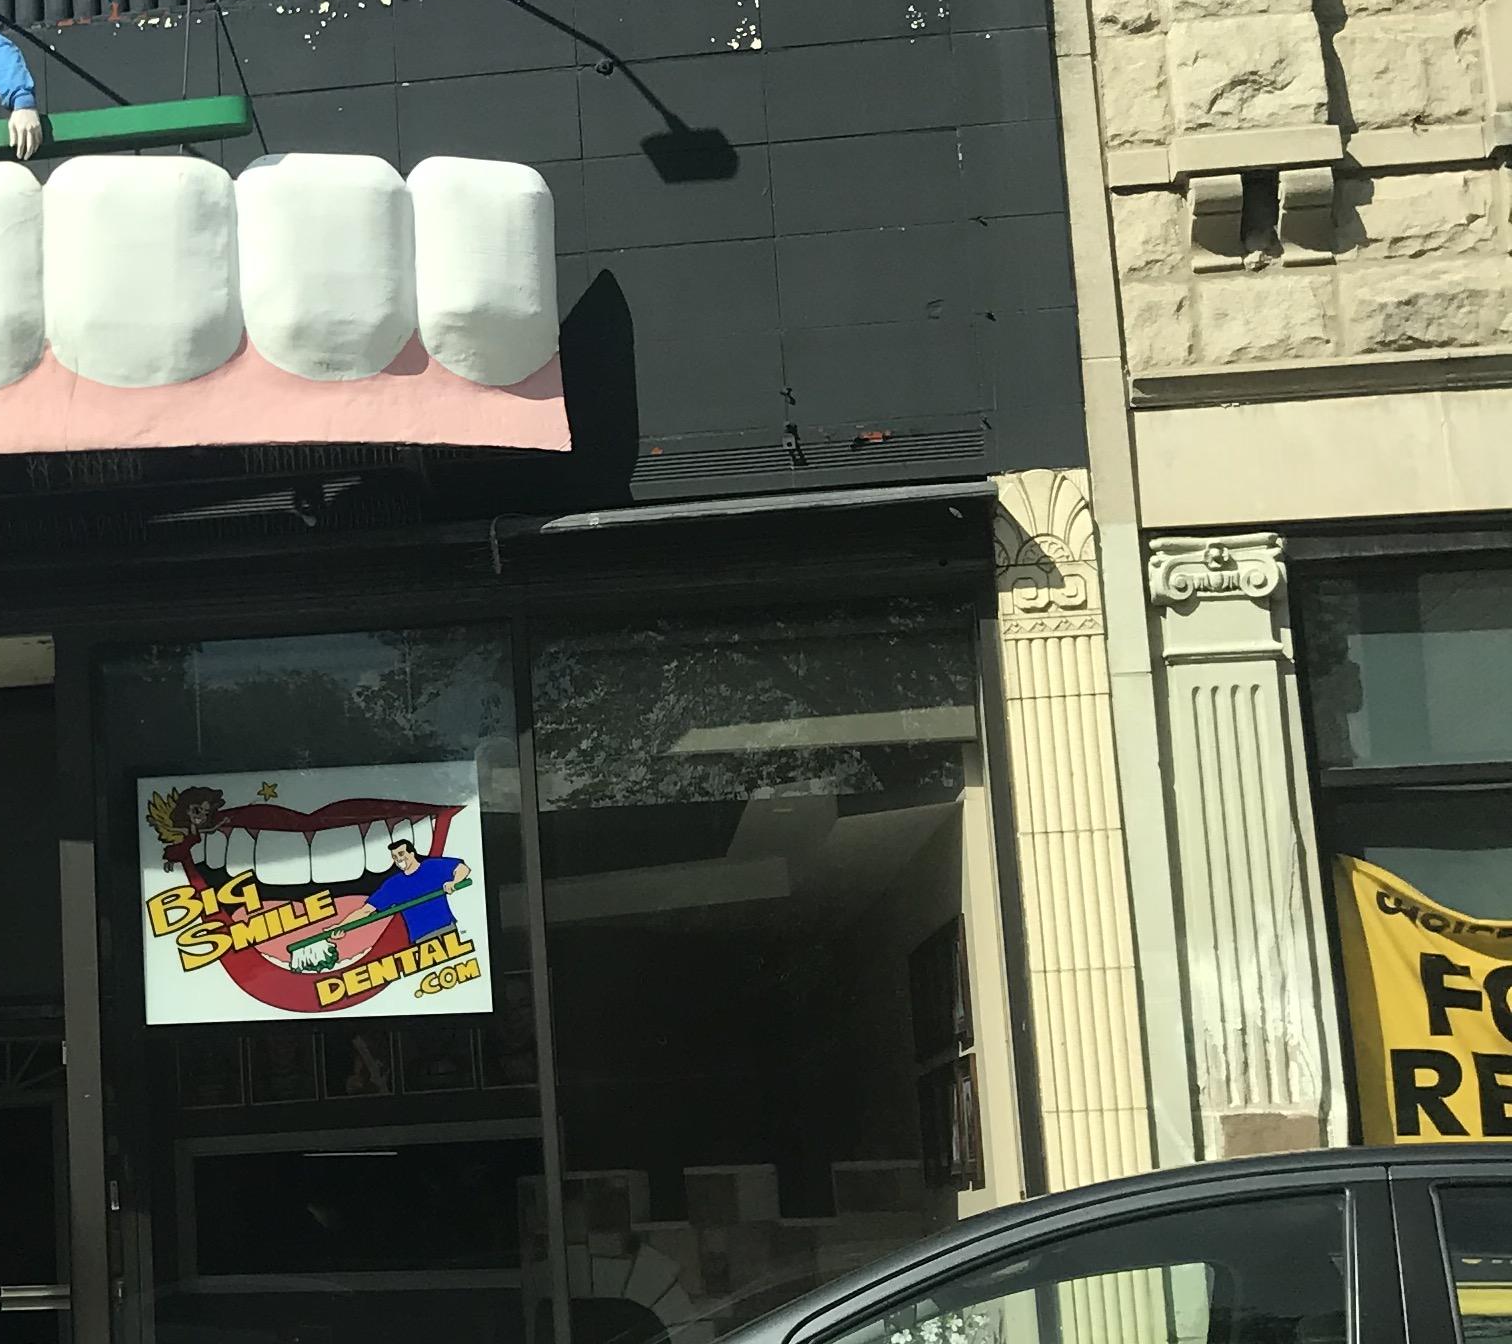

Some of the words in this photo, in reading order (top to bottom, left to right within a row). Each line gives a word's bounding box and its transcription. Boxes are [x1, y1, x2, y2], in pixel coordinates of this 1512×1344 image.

[146, 869, 264, 938] BIG
[175, 890, 338, 973] SMILE
[315, 929, 476, 1008] DENTAL
